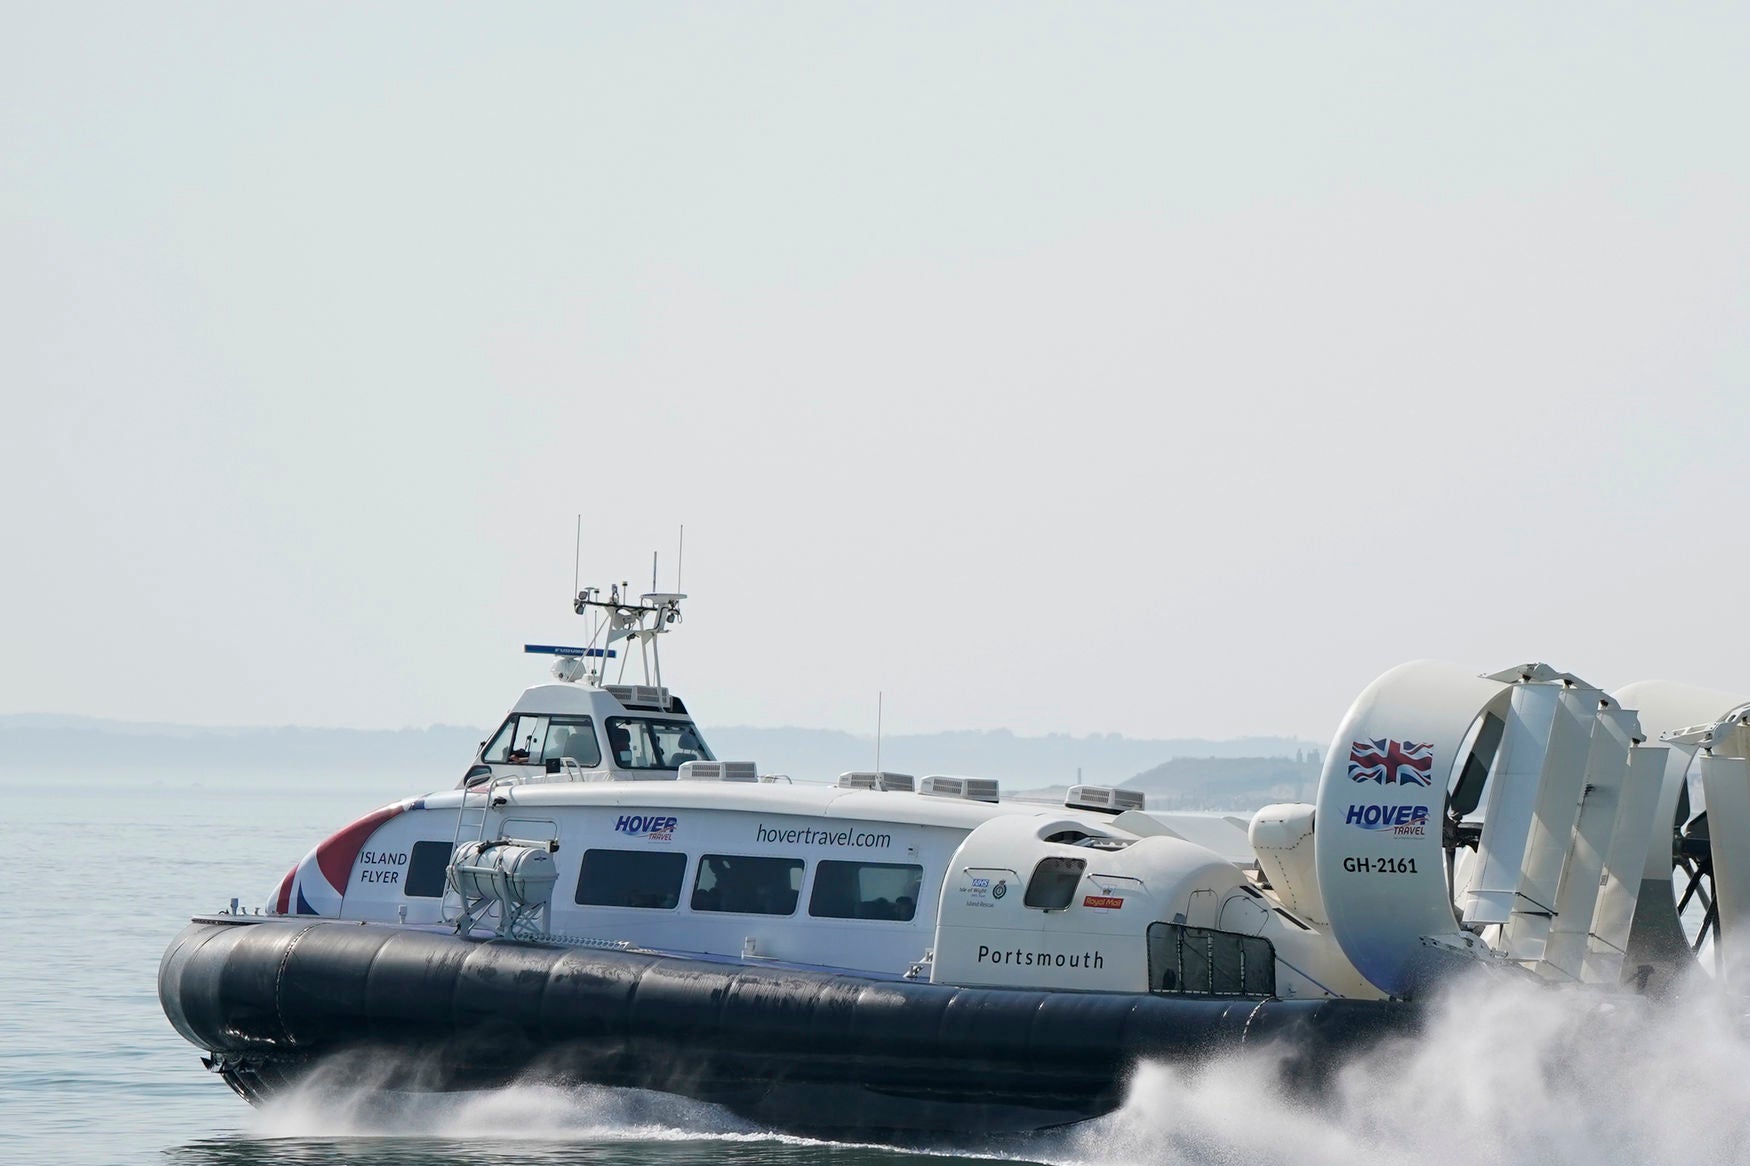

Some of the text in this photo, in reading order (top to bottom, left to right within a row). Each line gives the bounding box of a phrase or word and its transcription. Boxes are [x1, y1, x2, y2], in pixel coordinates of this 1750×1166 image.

[615, 815, 678, 832] HOVER
[1346, 805, 1428, 825] HOVER
[756, 824, 891, 848] hovertravel.com
[1394, 826, 1425, 835] TRAVEL
[360, 851, 407, 865] ISLAND
[1343, 857, 1418, 874] GH-2161
[361, 870, 399, 883] FLYER
[1087, 897, 1121, 906] Royal Mail
[978, 945, 1104, 969] Portsmouth
